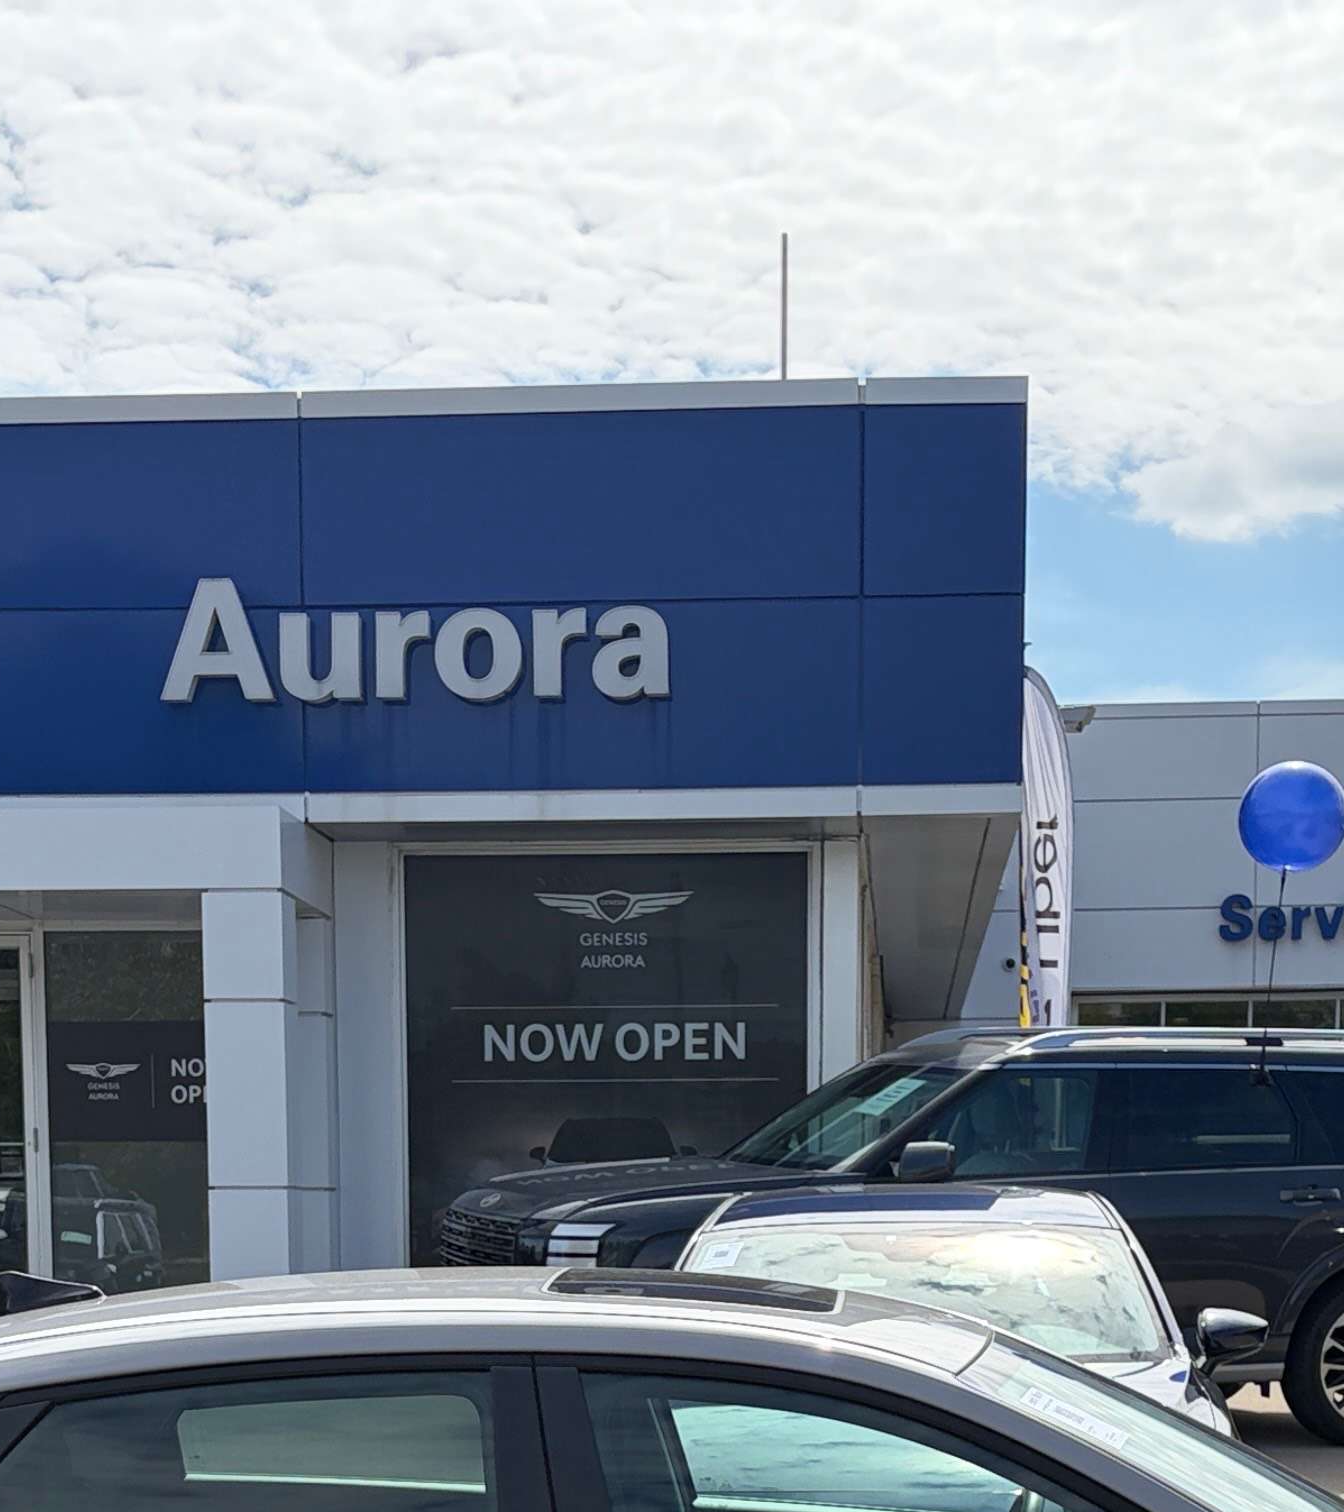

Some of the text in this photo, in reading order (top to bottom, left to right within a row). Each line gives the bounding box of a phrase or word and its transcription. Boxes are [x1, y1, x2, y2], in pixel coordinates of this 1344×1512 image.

[160, 577, 671, 703] Aurora
[579, 932, 648, 947] GENESIS
[580, 954, 646, 969] AURORA
[483, 1021, 746, 1063] NOW OPEN
[170, 1058, 206, 1077] NO
[88, 1082, 121, 1091] GENESIS
[87, 1092, 120, 1101] AURORA
